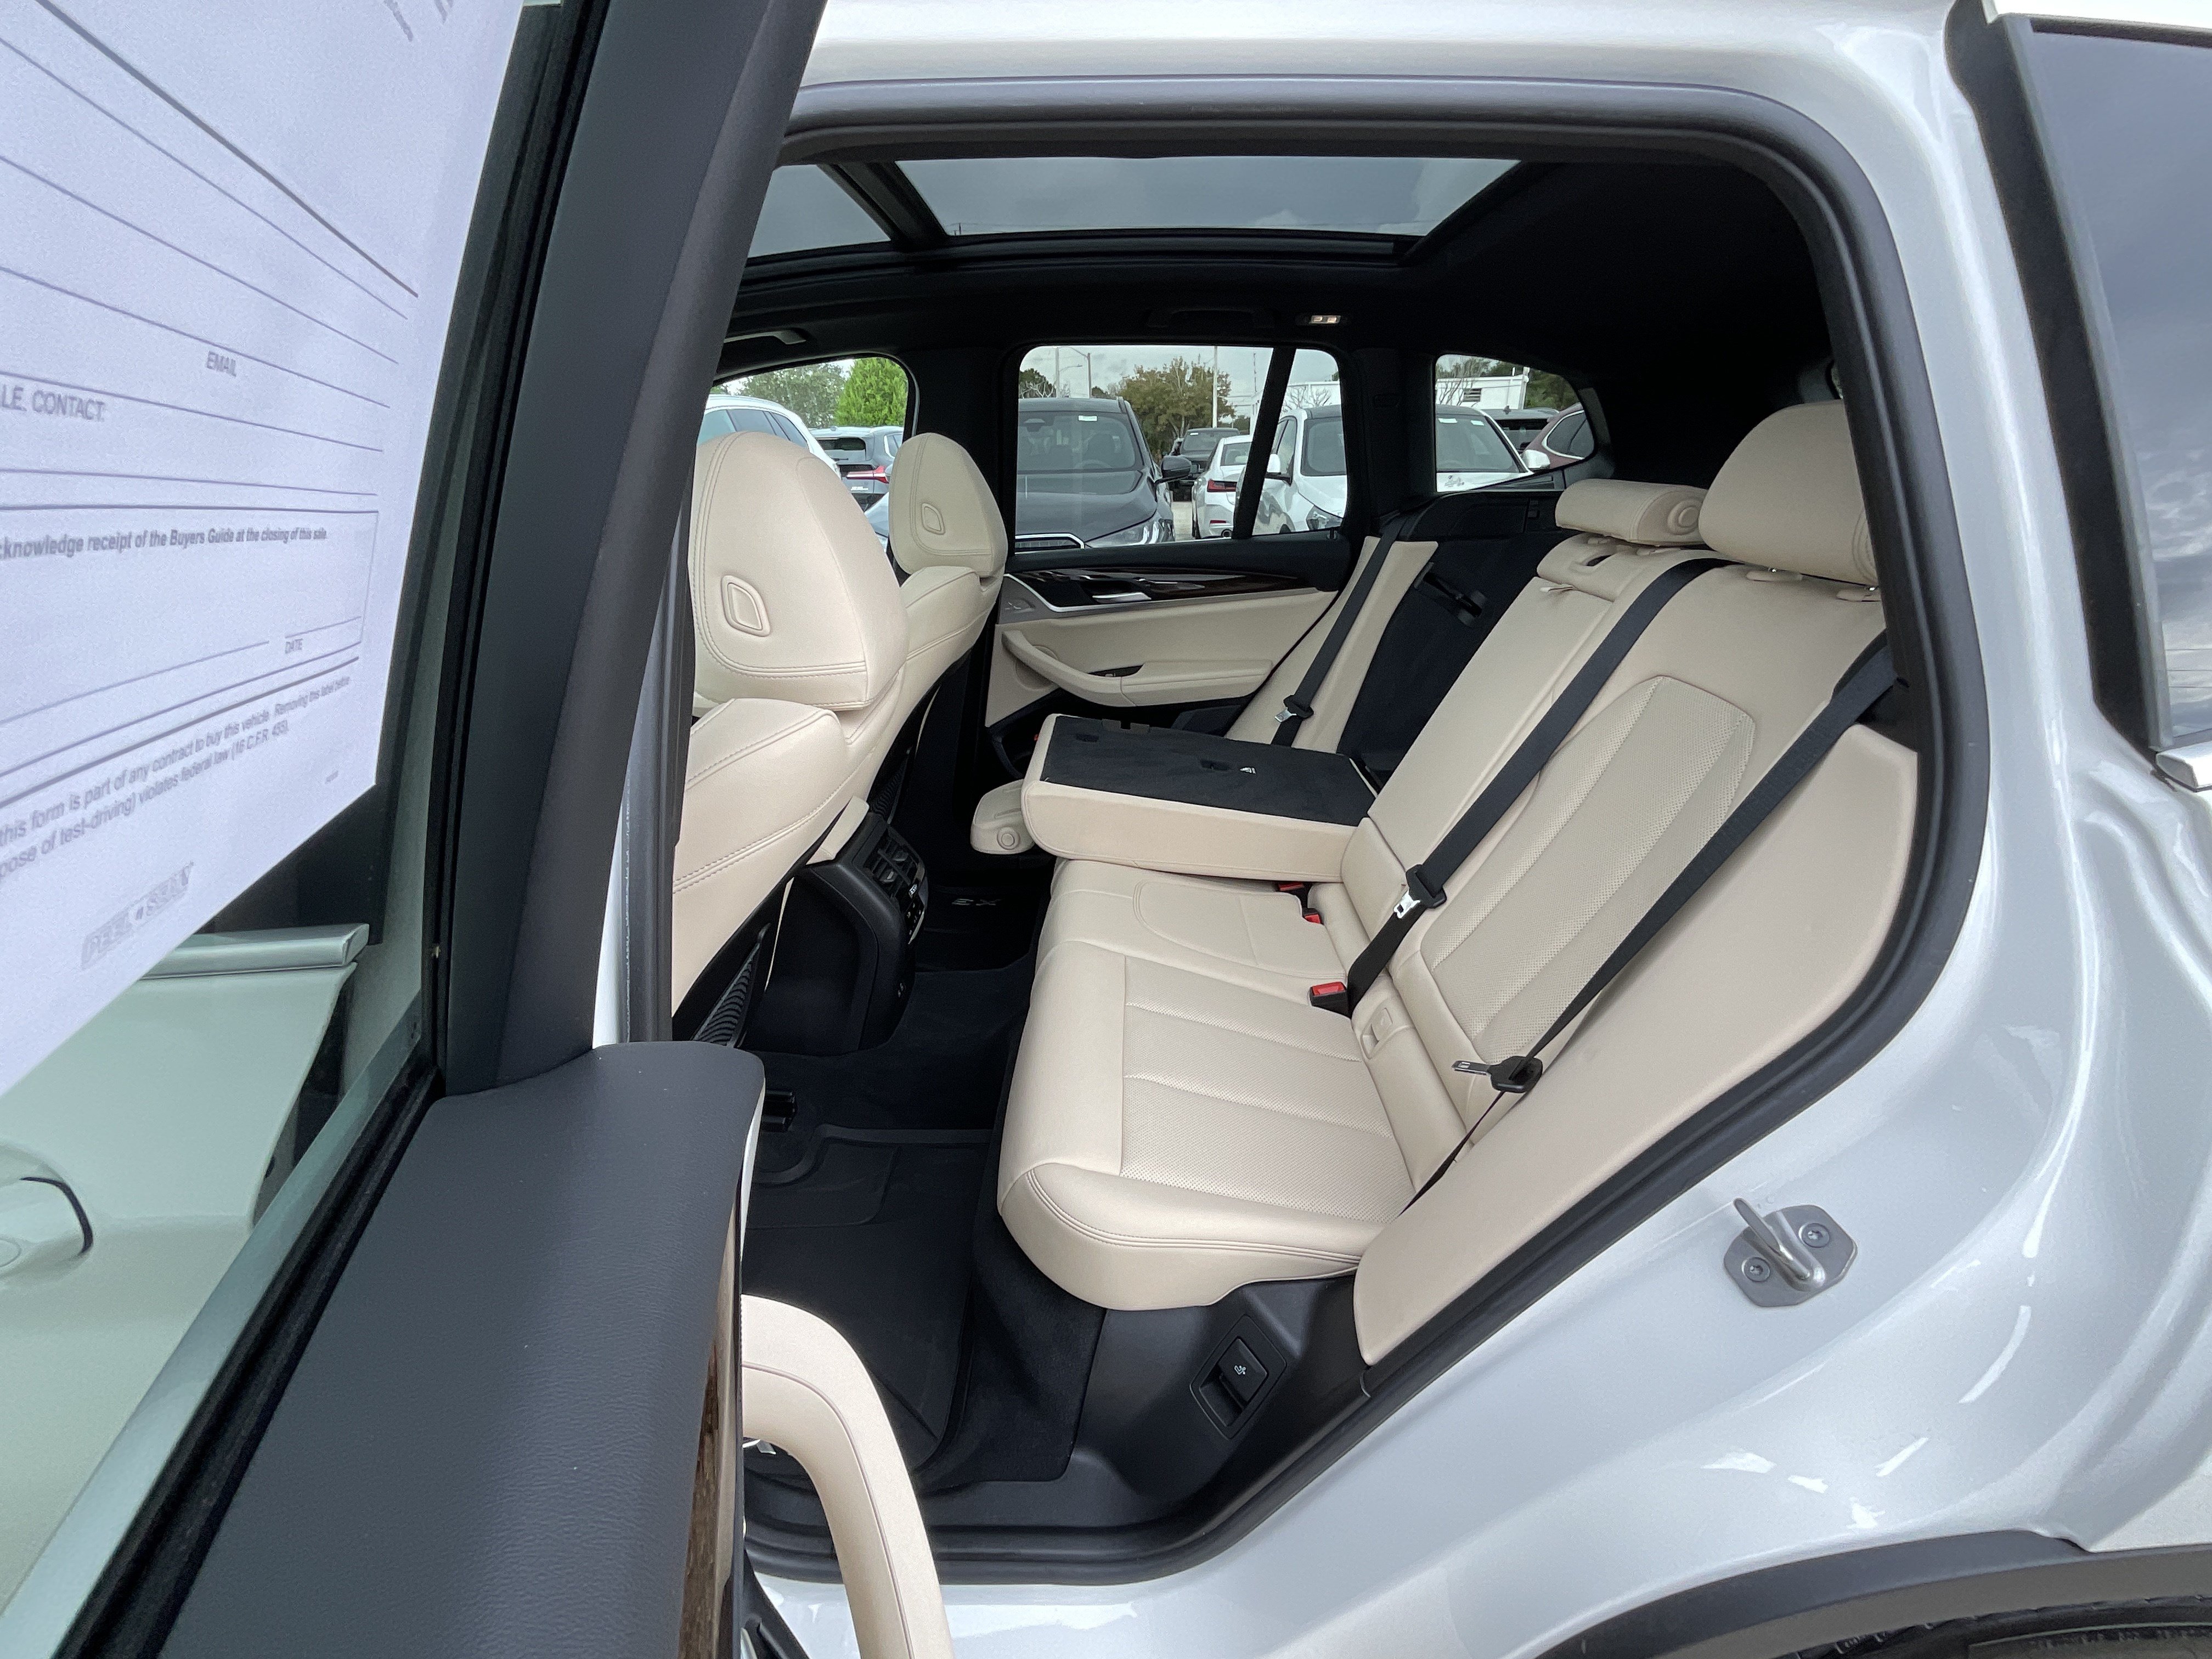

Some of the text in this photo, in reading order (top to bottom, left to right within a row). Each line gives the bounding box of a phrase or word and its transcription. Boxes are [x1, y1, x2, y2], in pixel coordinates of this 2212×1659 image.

[206, 350, 236, 377] EMAIL
[87, 531, 132, 554] receipt
[134, 530, 148, 548] of
[149, 530, 167, 547] the
[170, 528, 205, 549] Buyers
[207, 528, 234, 544] Guide
[235, 528, 245, 542] at
[246, 527, 259, 542] the
[261, 527, 289, 544] closing
[290, 527, 300, 540] of
[300, 527, 311, 539] this
[285, 638, 303, 653] DATE
[32, 803, 65, 830] form
[69, 794, 81, 811] is
[83, 777, 110, 810] part
[114, 769, 127, 790] of
[129, 764, 150, 783] any
[152, 742, 193, 772] contract
[195, 738, 204, 752] to
[206, 730, 223, 747] buy
[224, 721, 240, 739] this
[41, 830, 57, 855] of
[139, 774, 178, 803] violates
[181, 753, 213, 781] federal
[214, 749, 228, 764] law
